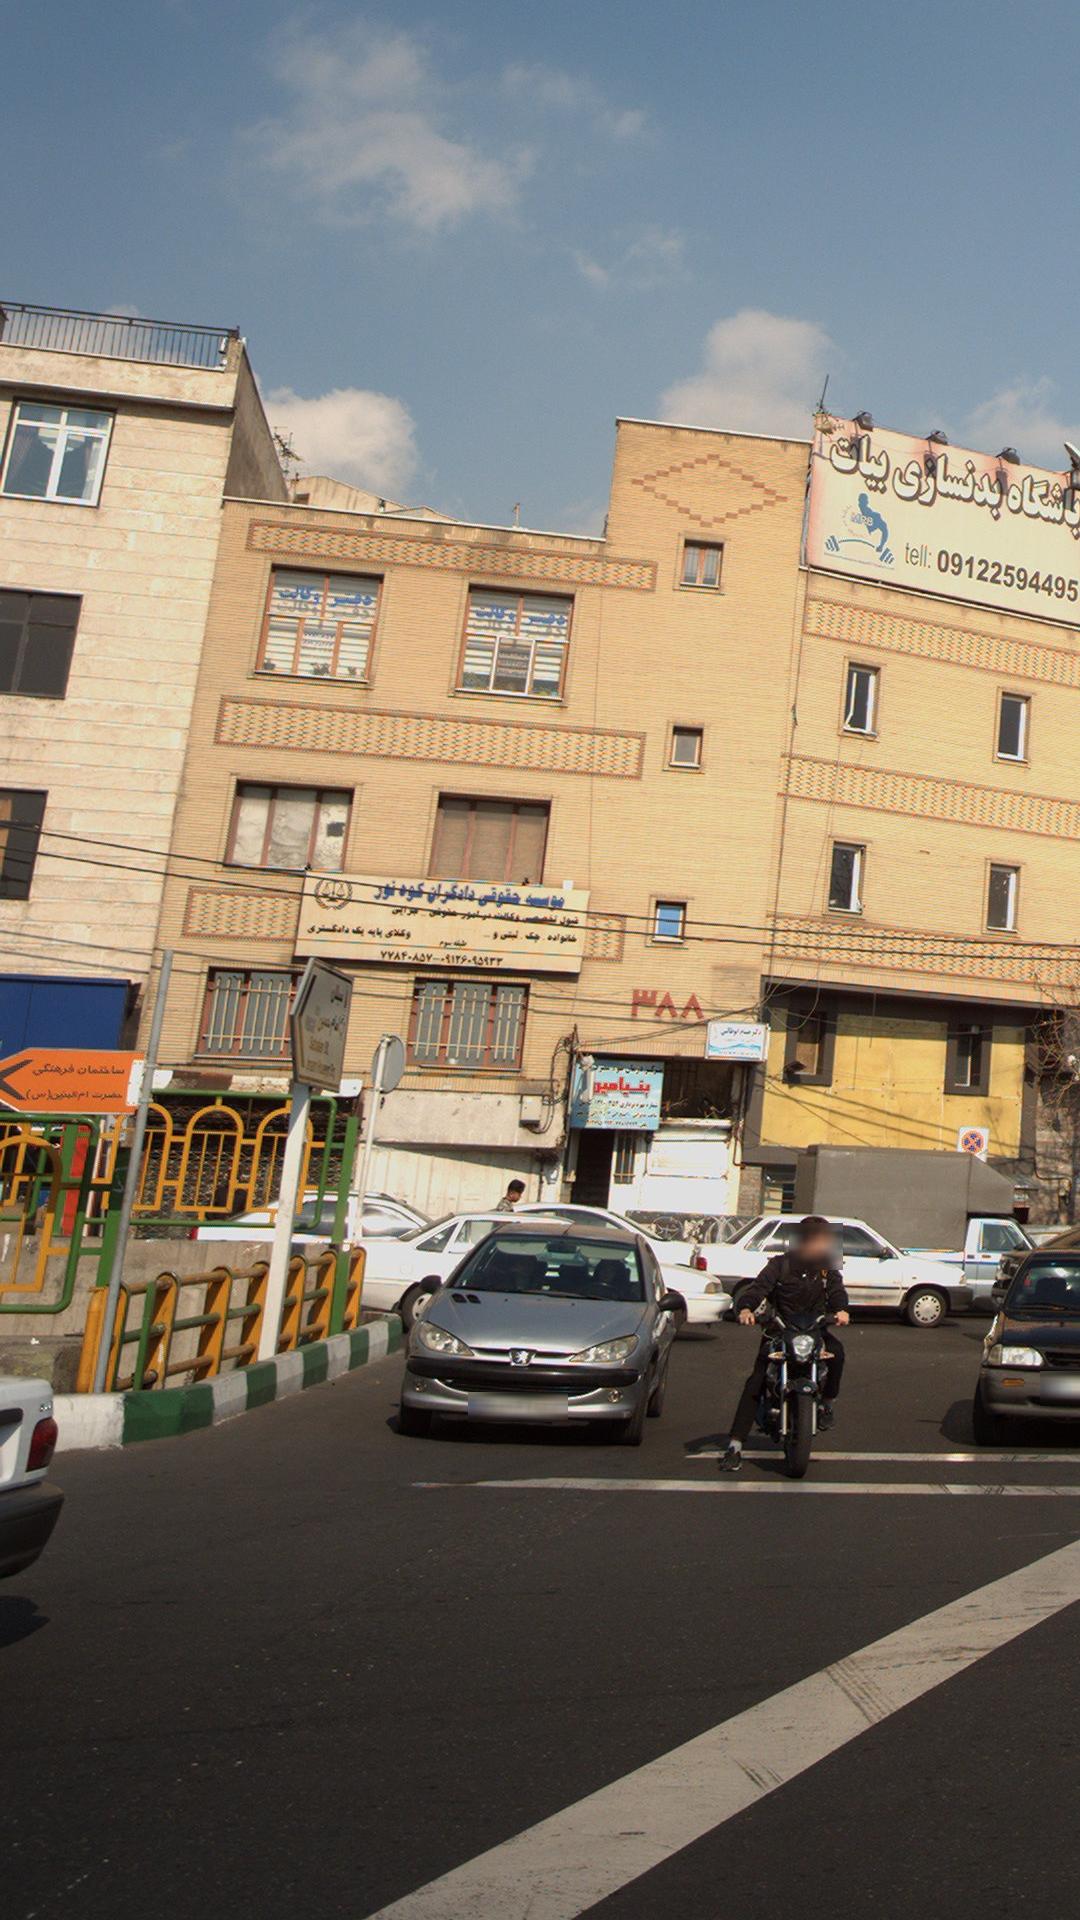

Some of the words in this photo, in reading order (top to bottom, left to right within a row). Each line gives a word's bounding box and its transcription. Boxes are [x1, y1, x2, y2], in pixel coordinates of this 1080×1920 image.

[829, 434, 890, 494] بیات
[892, 453, 1003, 521] بدنسازی
[1007, 475, 1080, 540] باشگاه
[905, 543, 933, 569] tell:
[937, 549, 1079, 602] 09122594495
[279, 585, 319, 606] وکالت
[329, 591, 373, 607] دفتر
[476, 602, 516, 623] وکالت
[528, 611, 567, 626] دفتر
[374, 880, 396, 901] نور
[428, 881, 475, 904] دادگران
[478, 886, 521, 908] حقوقی
[306, 923, 350, 935] دادگستری
[384, 929, 412, 940] وکلای
[547, 932, 577, 944] خانواده
[631, 988, 704, 1019] ۳۸۸
[32, 1063, 75, 1077] فرهنگی
[77, 1064, 125, 1075] ساختمان
[91, 1090, 123, 1101] حضرت
[593, 1075, 651, 1098] بنیامین
